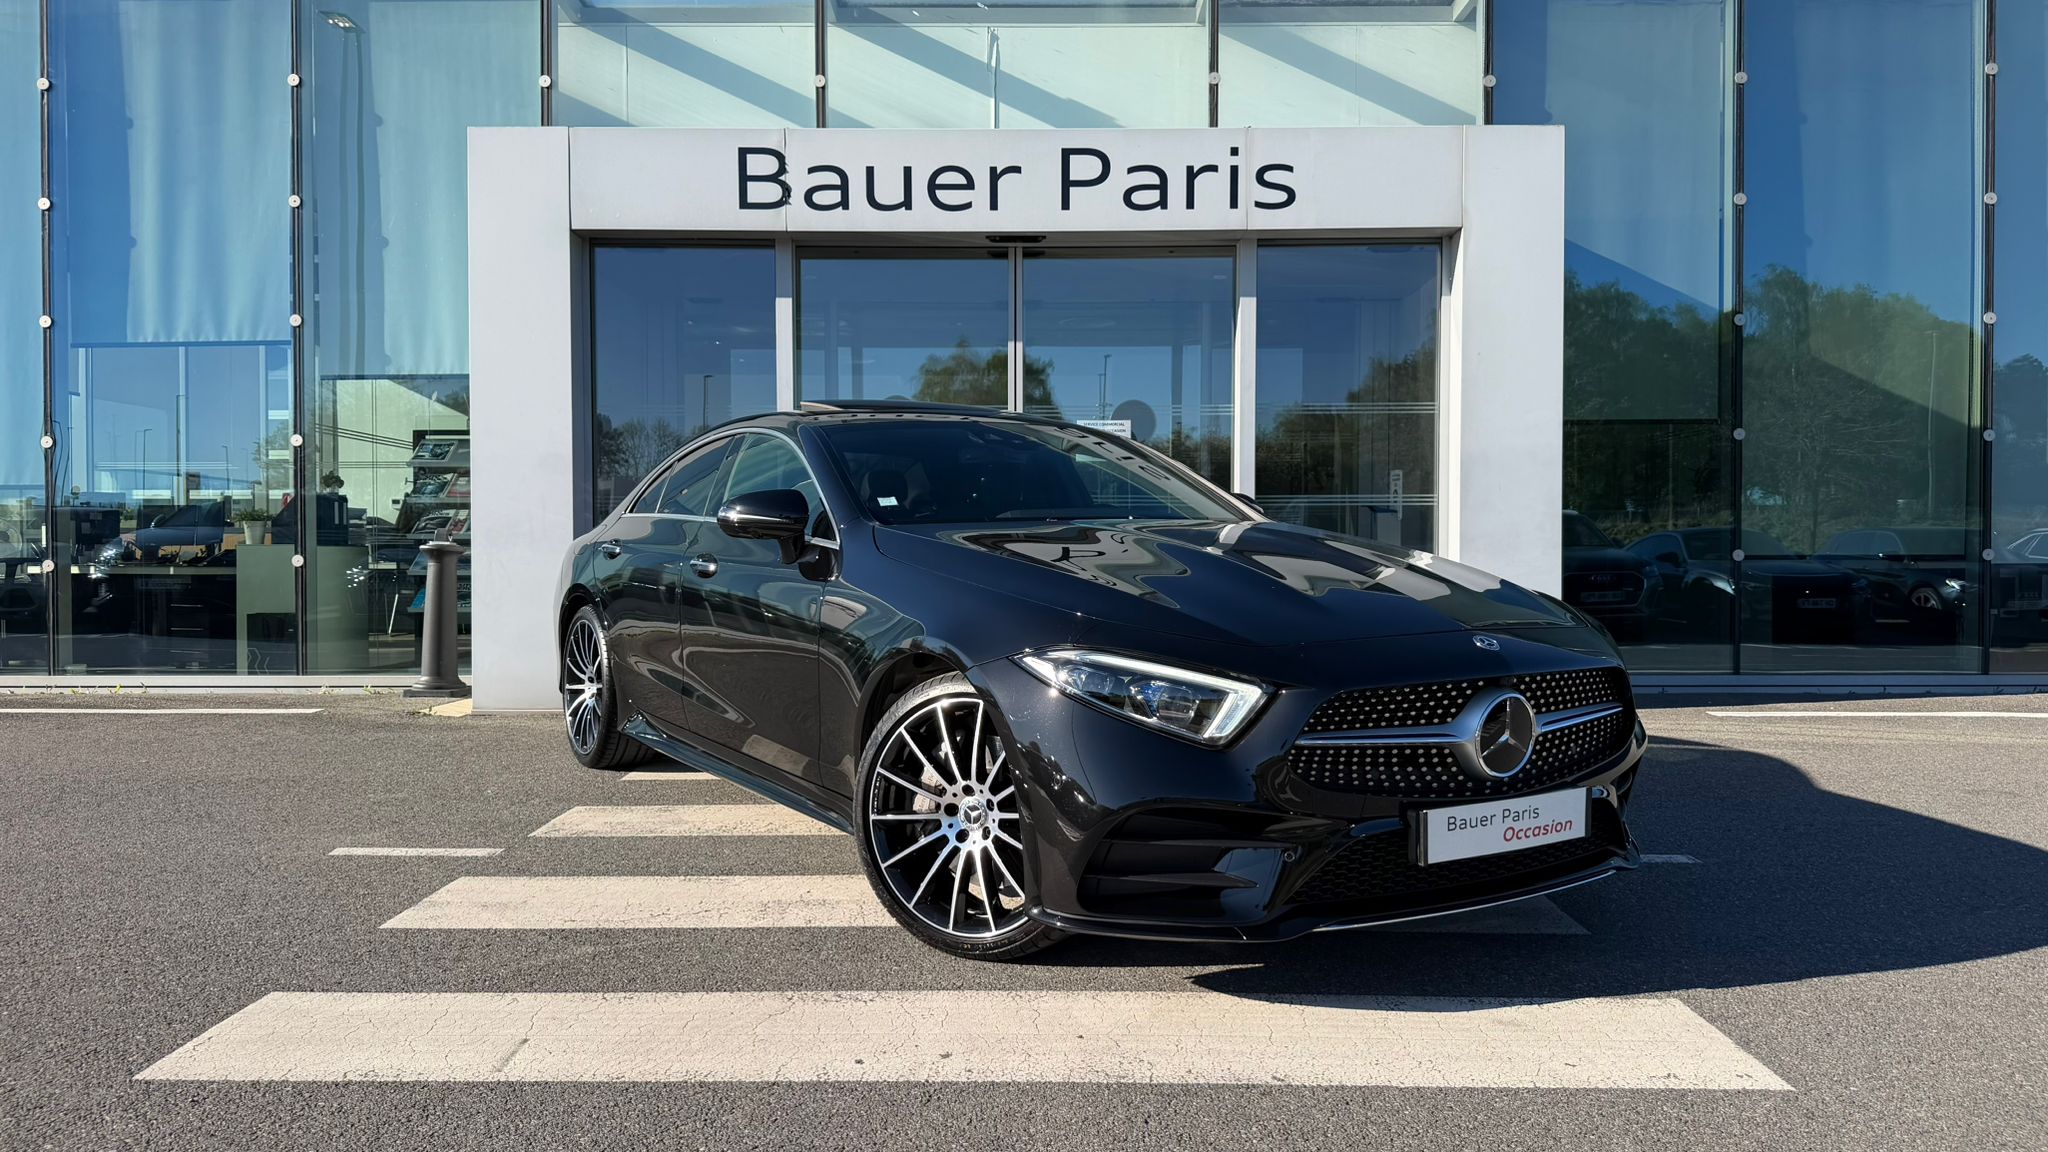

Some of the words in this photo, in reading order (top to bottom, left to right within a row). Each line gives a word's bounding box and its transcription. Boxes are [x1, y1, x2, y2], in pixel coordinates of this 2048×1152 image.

[737, 146, 1022, 211] Bauer
[1060, 146, 1297, 211] Paris
[1447, 813, 1496, 832] Bauer
[1502, 805, 1540, 823] Paris
[1503, 818, 1573, 842] Occasion
